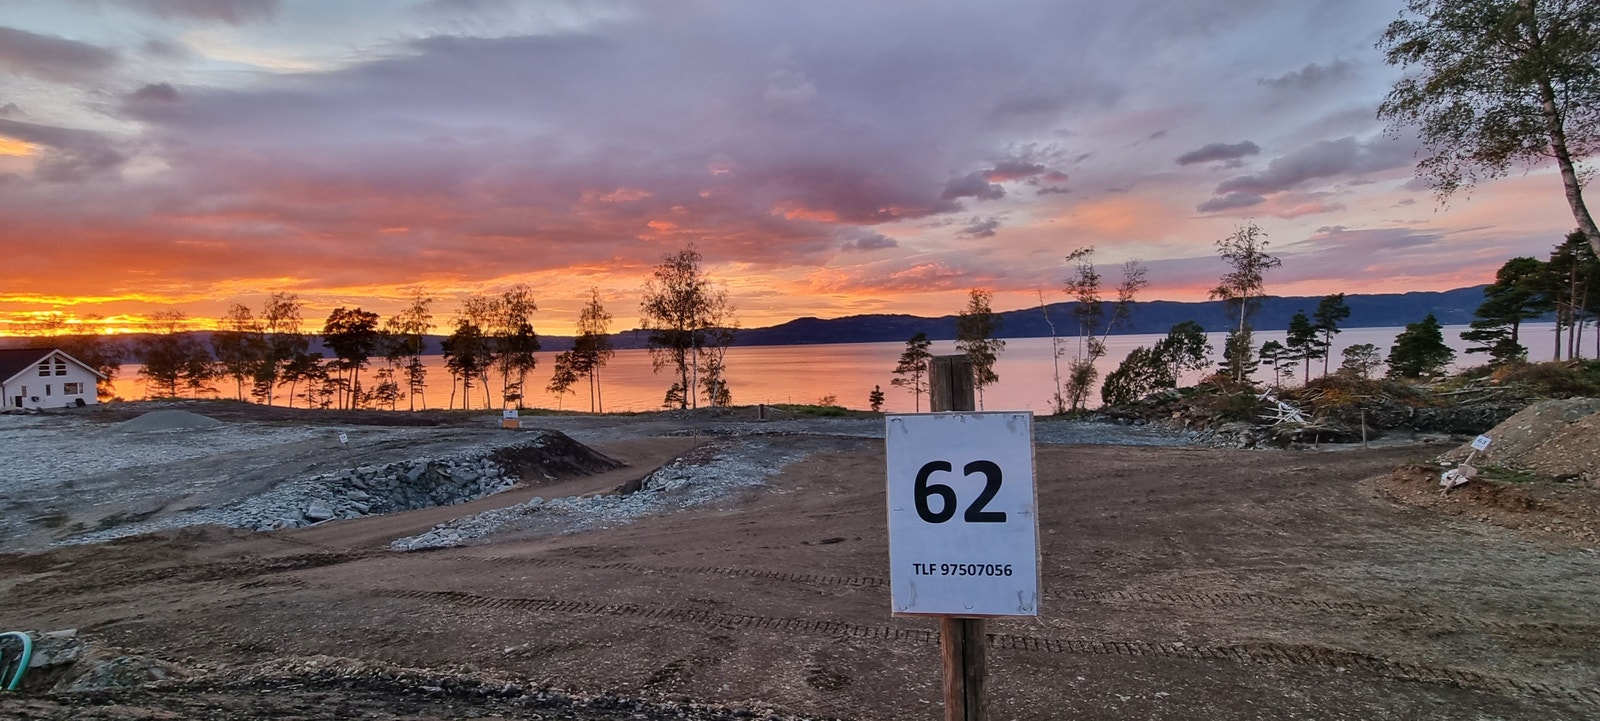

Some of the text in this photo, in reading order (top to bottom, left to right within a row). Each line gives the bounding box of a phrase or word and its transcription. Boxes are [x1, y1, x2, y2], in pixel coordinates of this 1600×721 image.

[914, 460, 1007, 523] 62
[913, 563, 1012, 576] TLF 97507056
